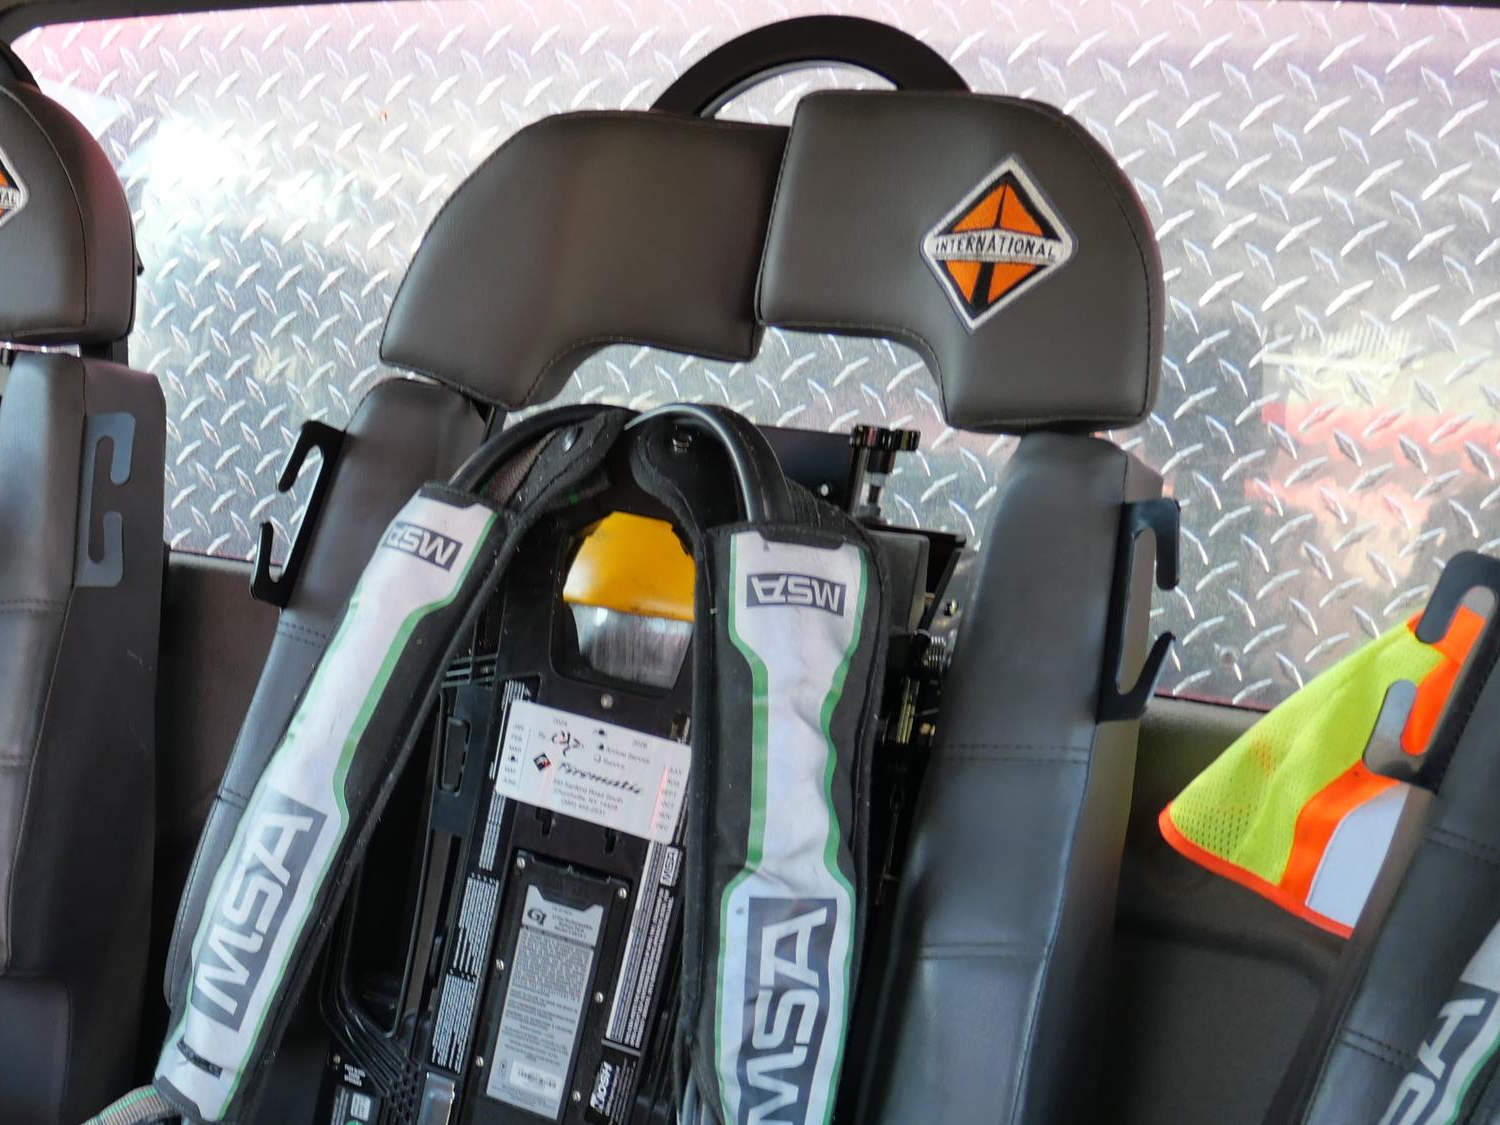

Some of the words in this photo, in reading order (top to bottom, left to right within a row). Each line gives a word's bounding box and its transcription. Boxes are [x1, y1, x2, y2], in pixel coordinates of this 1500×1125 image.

[934, 233, 1054, 258] INTERNATIONAL
[385, 524, 457, 567] MSA
[750, 573, 842, 614] MSA
[193, 806, 315, 1016] MSA
